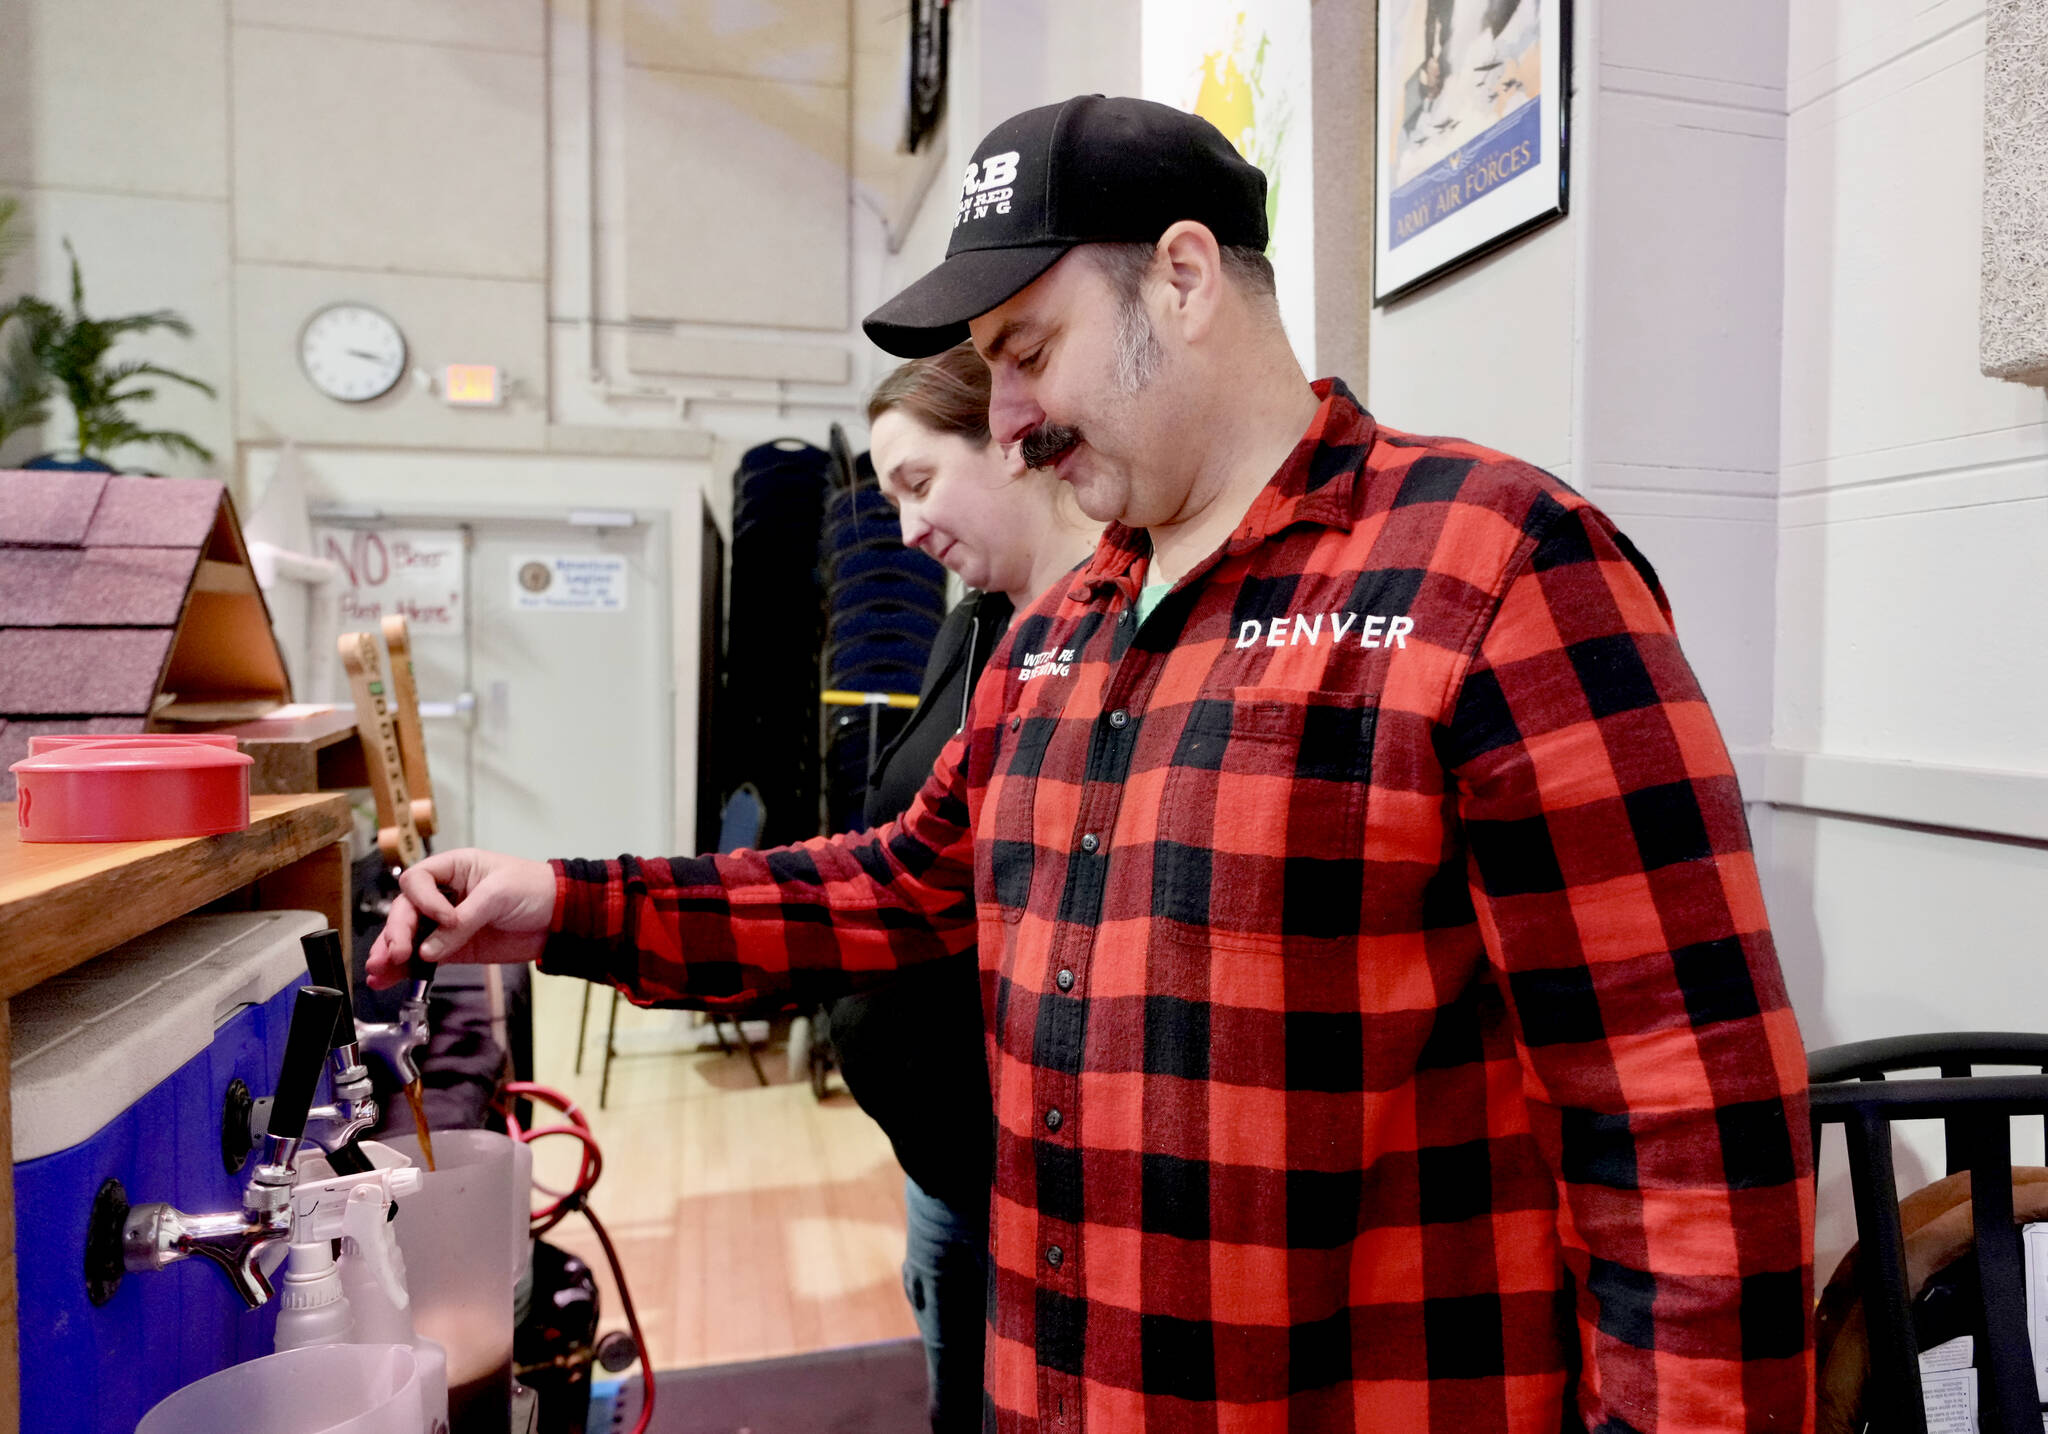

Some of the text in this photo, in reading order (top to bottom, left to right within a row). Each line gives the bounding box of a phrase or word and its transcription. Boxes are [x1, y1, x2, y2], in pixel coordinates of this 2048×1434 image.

[973, 187, 1014, 208] RED
[1396, 203, 1430, 239] ARMY
[1434, 183, 1462, 218] AIR
[1464, 139, 1532, 199] FORCES
[1234, 611, 1415, 649] DENVER
